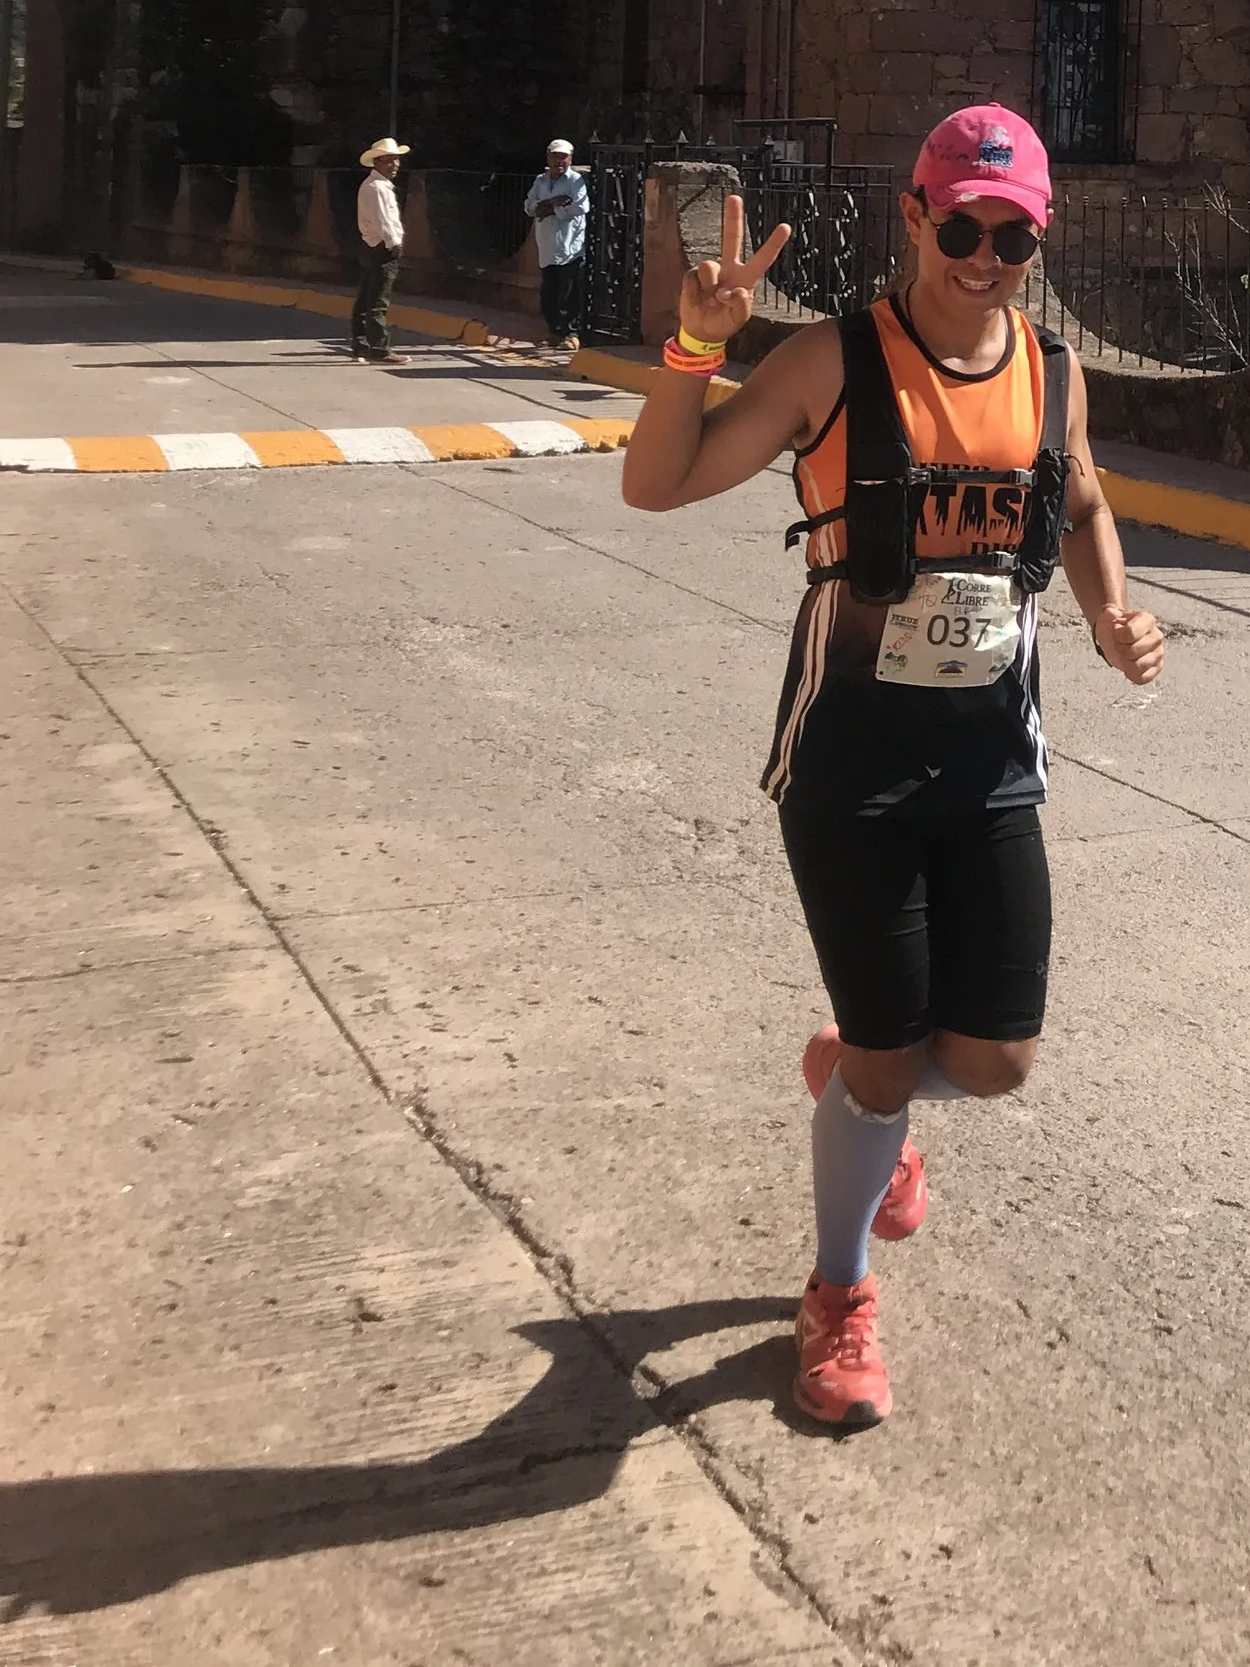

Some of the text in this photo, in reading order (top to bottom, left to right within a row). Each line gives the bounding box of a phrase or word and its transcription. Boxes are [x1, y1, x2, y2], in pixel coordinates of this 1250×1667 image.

[956, 578, 992, 593] CORRE
[955, 592, 990, 606] LIBRE
[926, 614, 992, 648] 037
